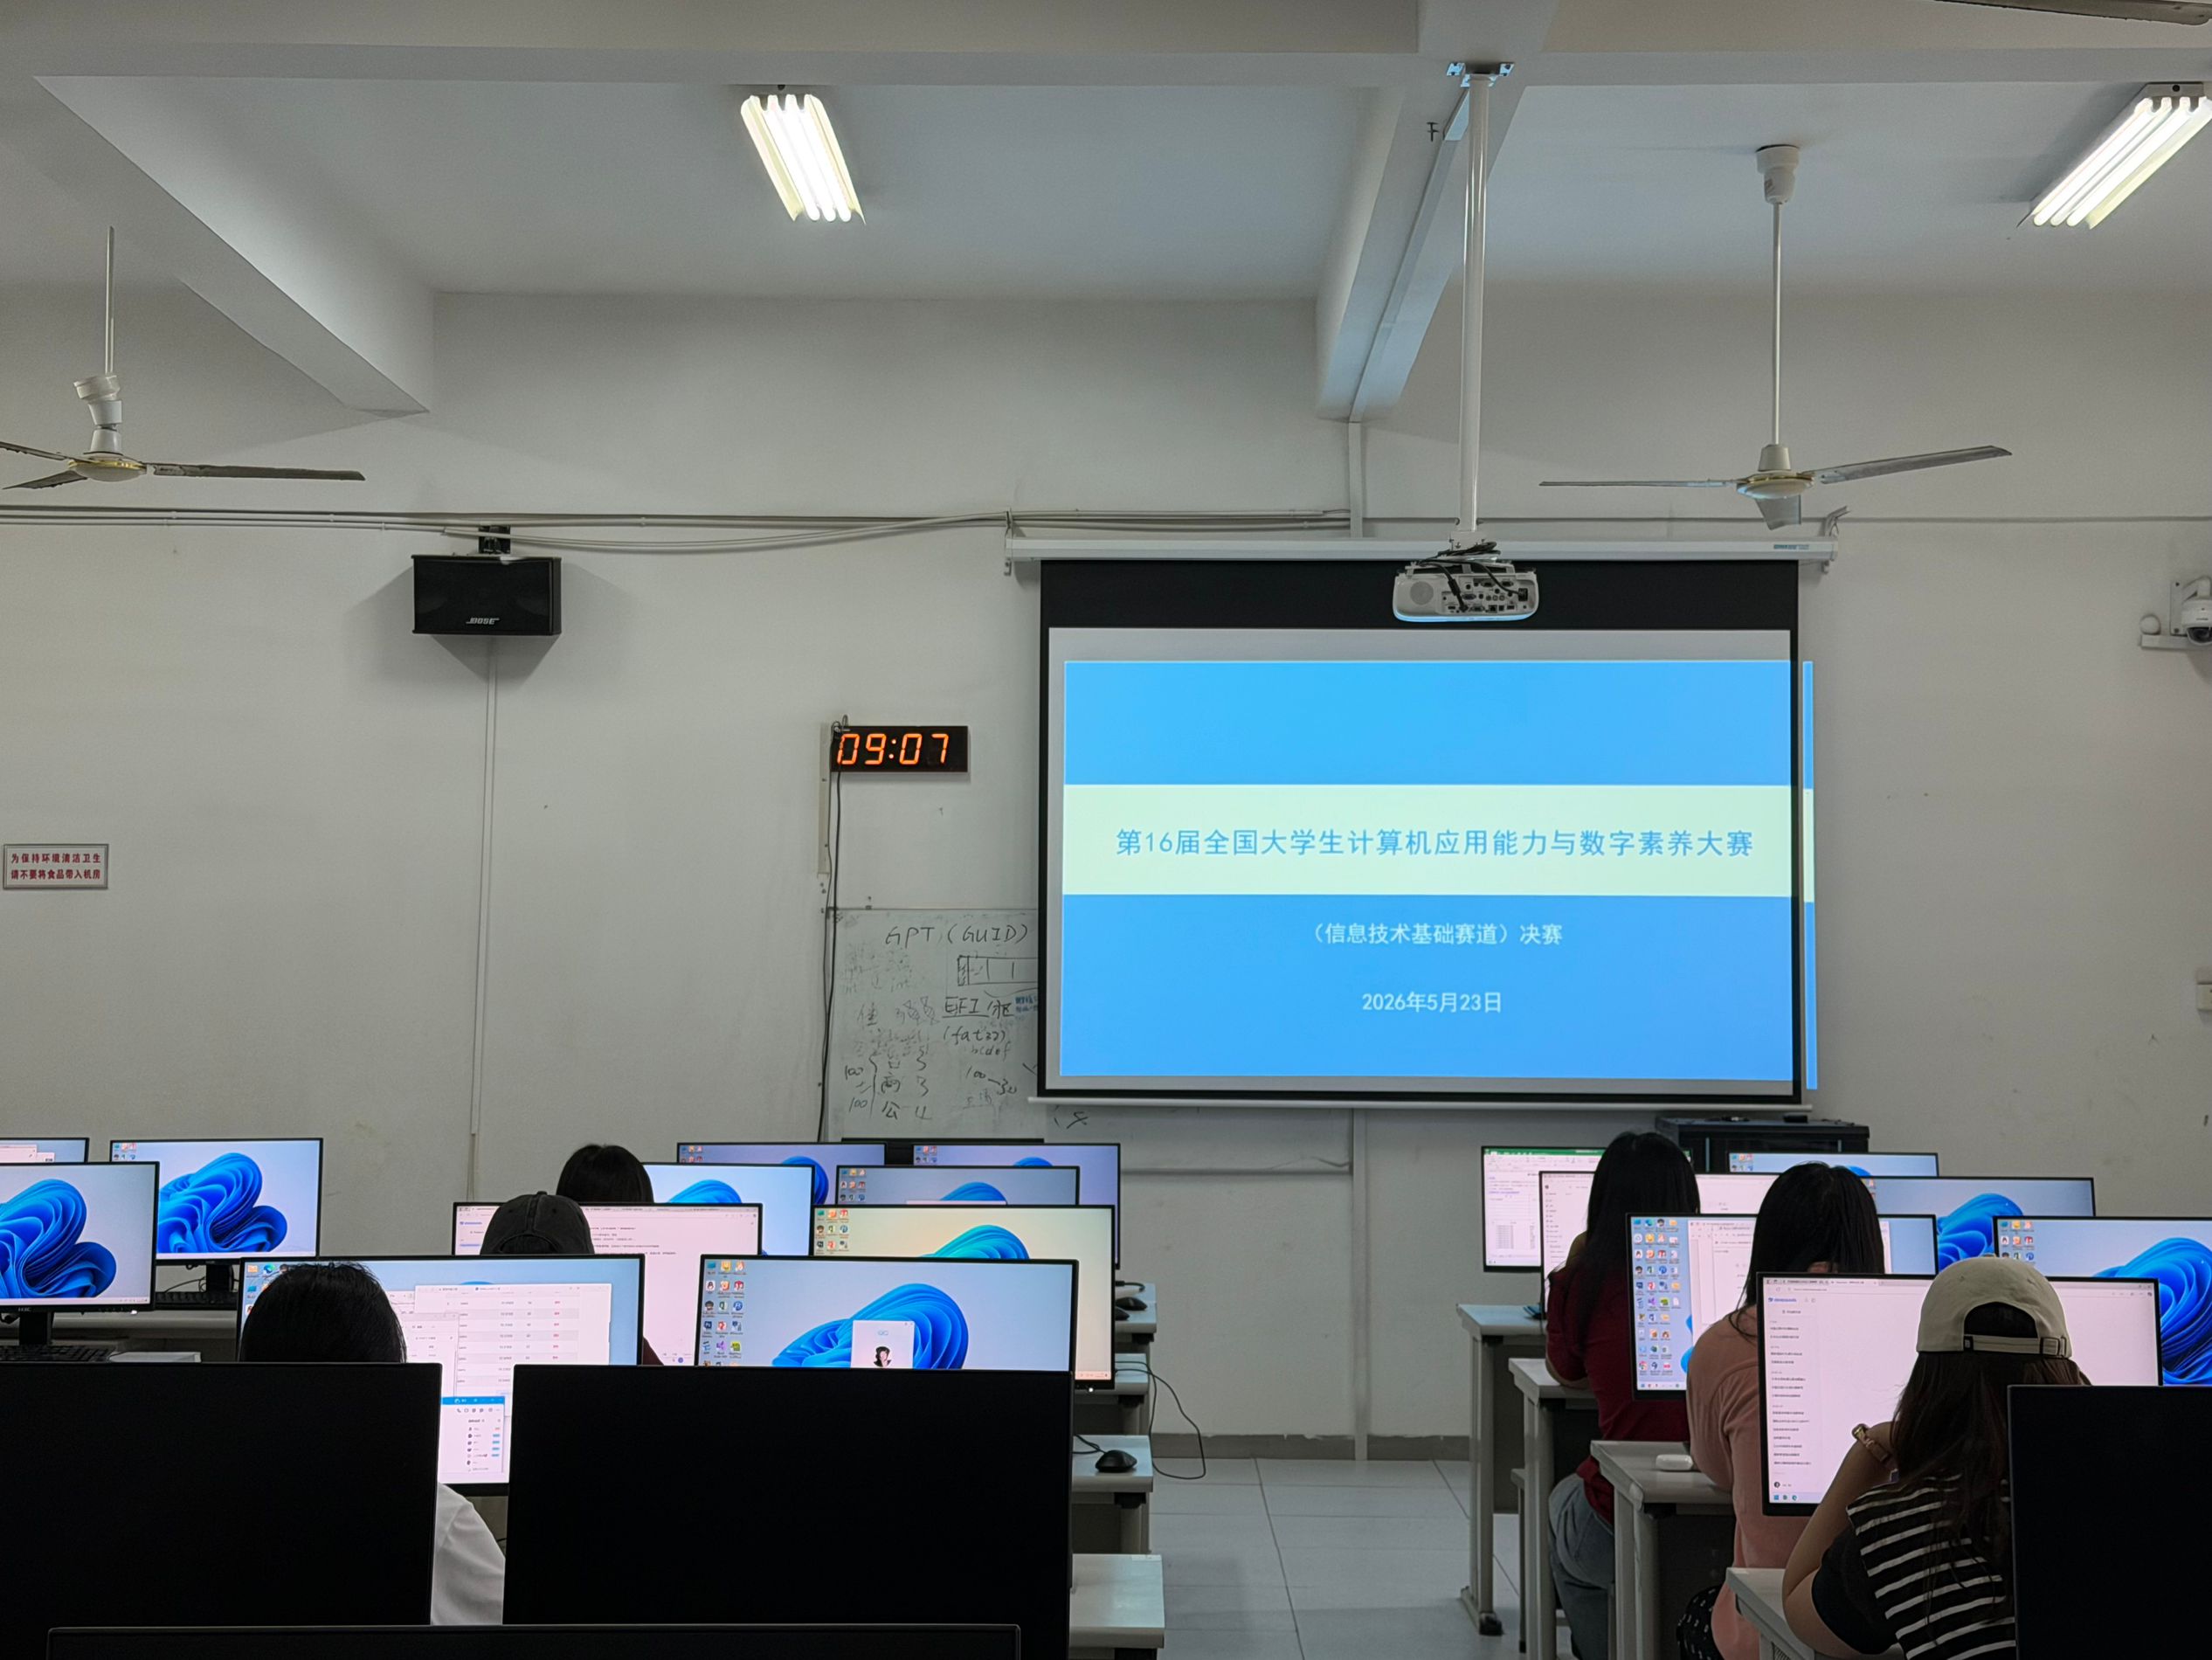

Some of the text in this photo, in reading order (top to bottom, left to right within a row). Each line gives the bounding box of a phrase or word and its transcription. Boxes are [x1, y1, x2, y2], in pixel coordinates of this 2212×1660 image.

[836, 733, 950, 765] 09:07
[1116, 828, 1753, 857] 第16届全国大学生计算机应用能力与数字素养大赛
[10, 853, 101, 863] 为保持环境清洁卫生
[10, 869, 101, 880] 请不要将食品带入机房
[885, 923, 1027, 949] GPT (GUID)
[1361, 991, 1502, 1013] 2026年5月23日
